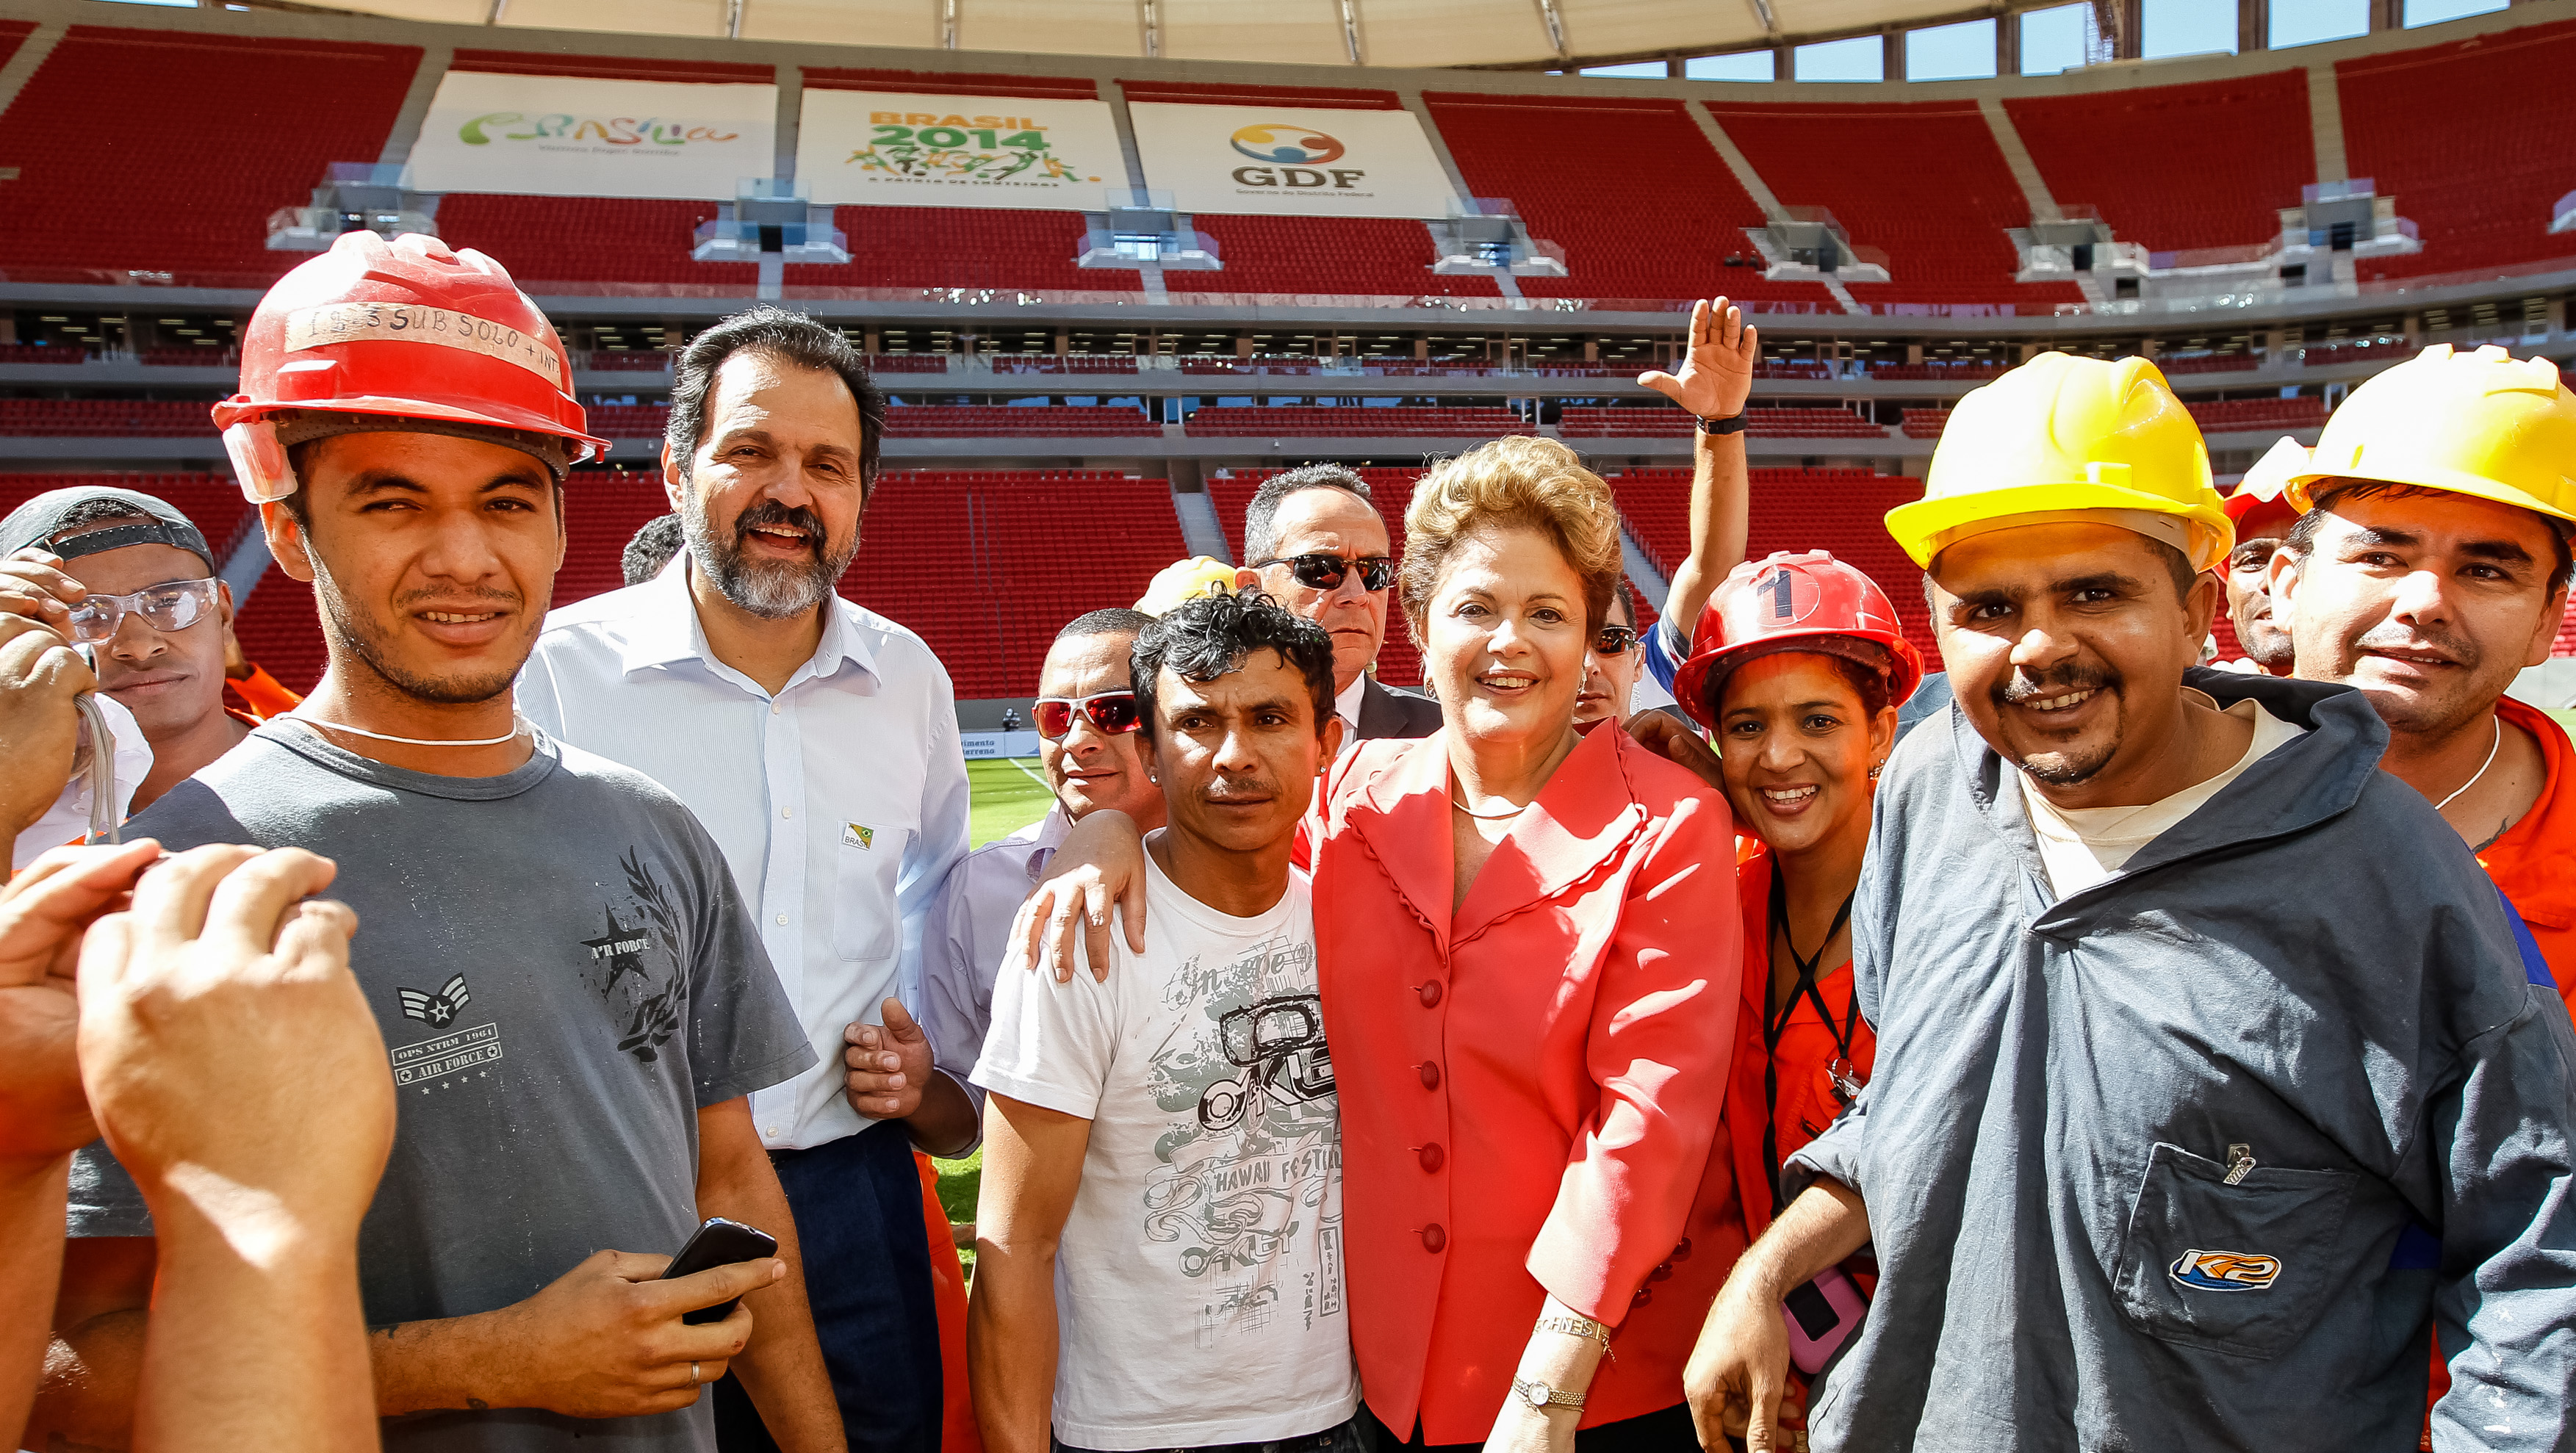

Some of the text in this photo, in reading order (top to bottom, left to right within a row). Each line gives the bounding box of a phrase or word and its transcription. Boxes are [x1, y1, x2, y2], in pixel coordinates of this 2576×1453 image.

[869, 112, 1048, 131] BRASIL
[869, 125, 1051, 151] 2014
[1231, 166, 1367, 188] GDF
[389, 309, 448, 331] SUB
[1757, 570, 1793, 618] 1
[844, 836, 870, 849] BRASIL
[614, 938, 650, 955] FORCE
[398, 1047, 423, 1059] OPS
[426, 1037, 459, 1053] XTRM
[418, 1050, 485, 1078] AIR FORCE
[1215, 1159, 1270, 1193] HAWAII
[2178, 1251, 2277, 1280] K2
